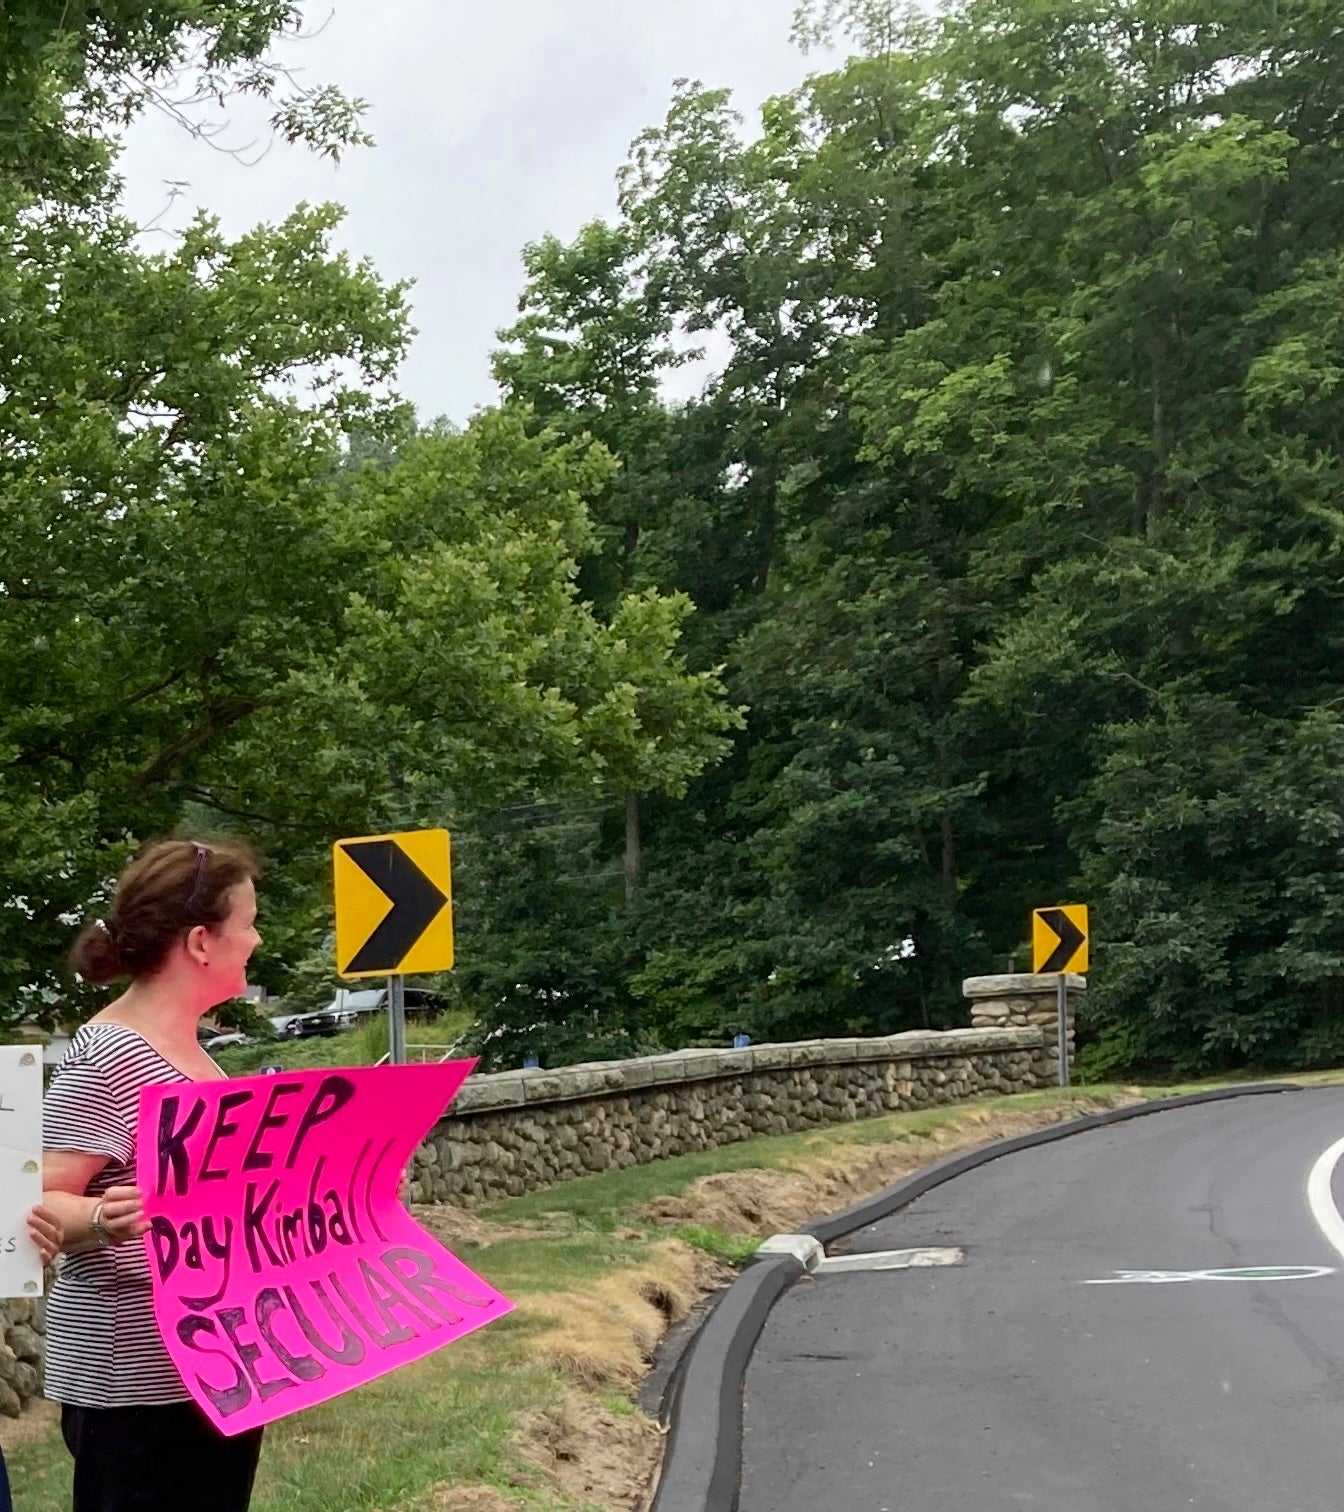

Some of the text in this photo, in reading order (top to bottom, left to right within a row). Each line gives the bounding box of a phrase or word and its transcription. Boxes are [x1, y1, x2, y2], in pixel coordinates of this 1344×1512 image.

[156, 1075, 357, 1198] KEEP
[150, 1138, 396, 1311] Day Kimball
[175, 1247, 496, 1418] SECULAR
